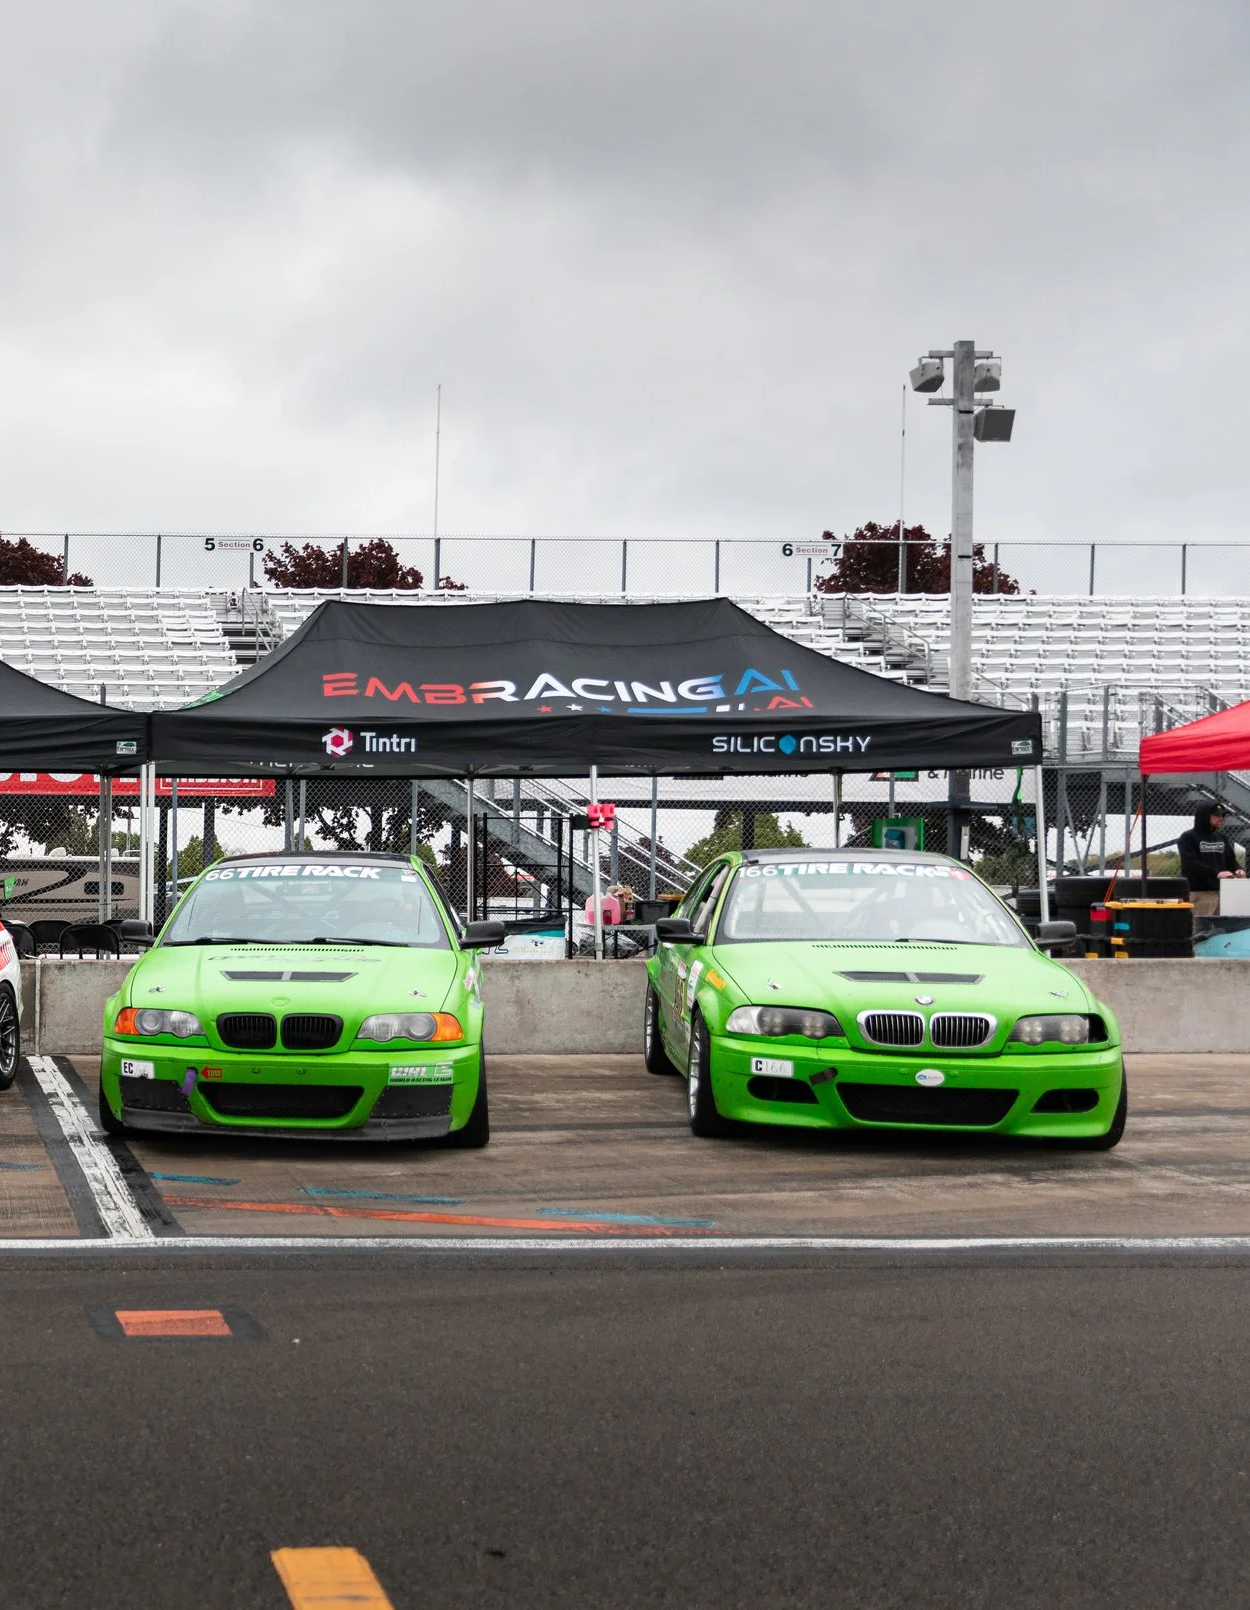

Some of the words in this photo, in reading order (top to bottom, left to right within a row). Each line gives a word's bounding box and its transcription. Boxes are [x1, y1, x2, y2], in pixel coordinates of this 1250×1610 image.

[204, 538, 216, 551] 5
[252, 538, 264, 552] 6
[782, 543, 793, 557] 6
[795, 546, 828, 554] Section
[831, 543, 842, 557] 7
[360, 732, 416, 753] Tintri
[236, 865, 300, 879] TIRE
[301, 865, 382, 879] RACK
[738, 866, 778, 878] 166
[776, 863, 848, 875] TIRE
[853, 862, 936, 878] RACK
[123, 1062, 134, 1074] EC
[755, 1060, 762, 1072] C
